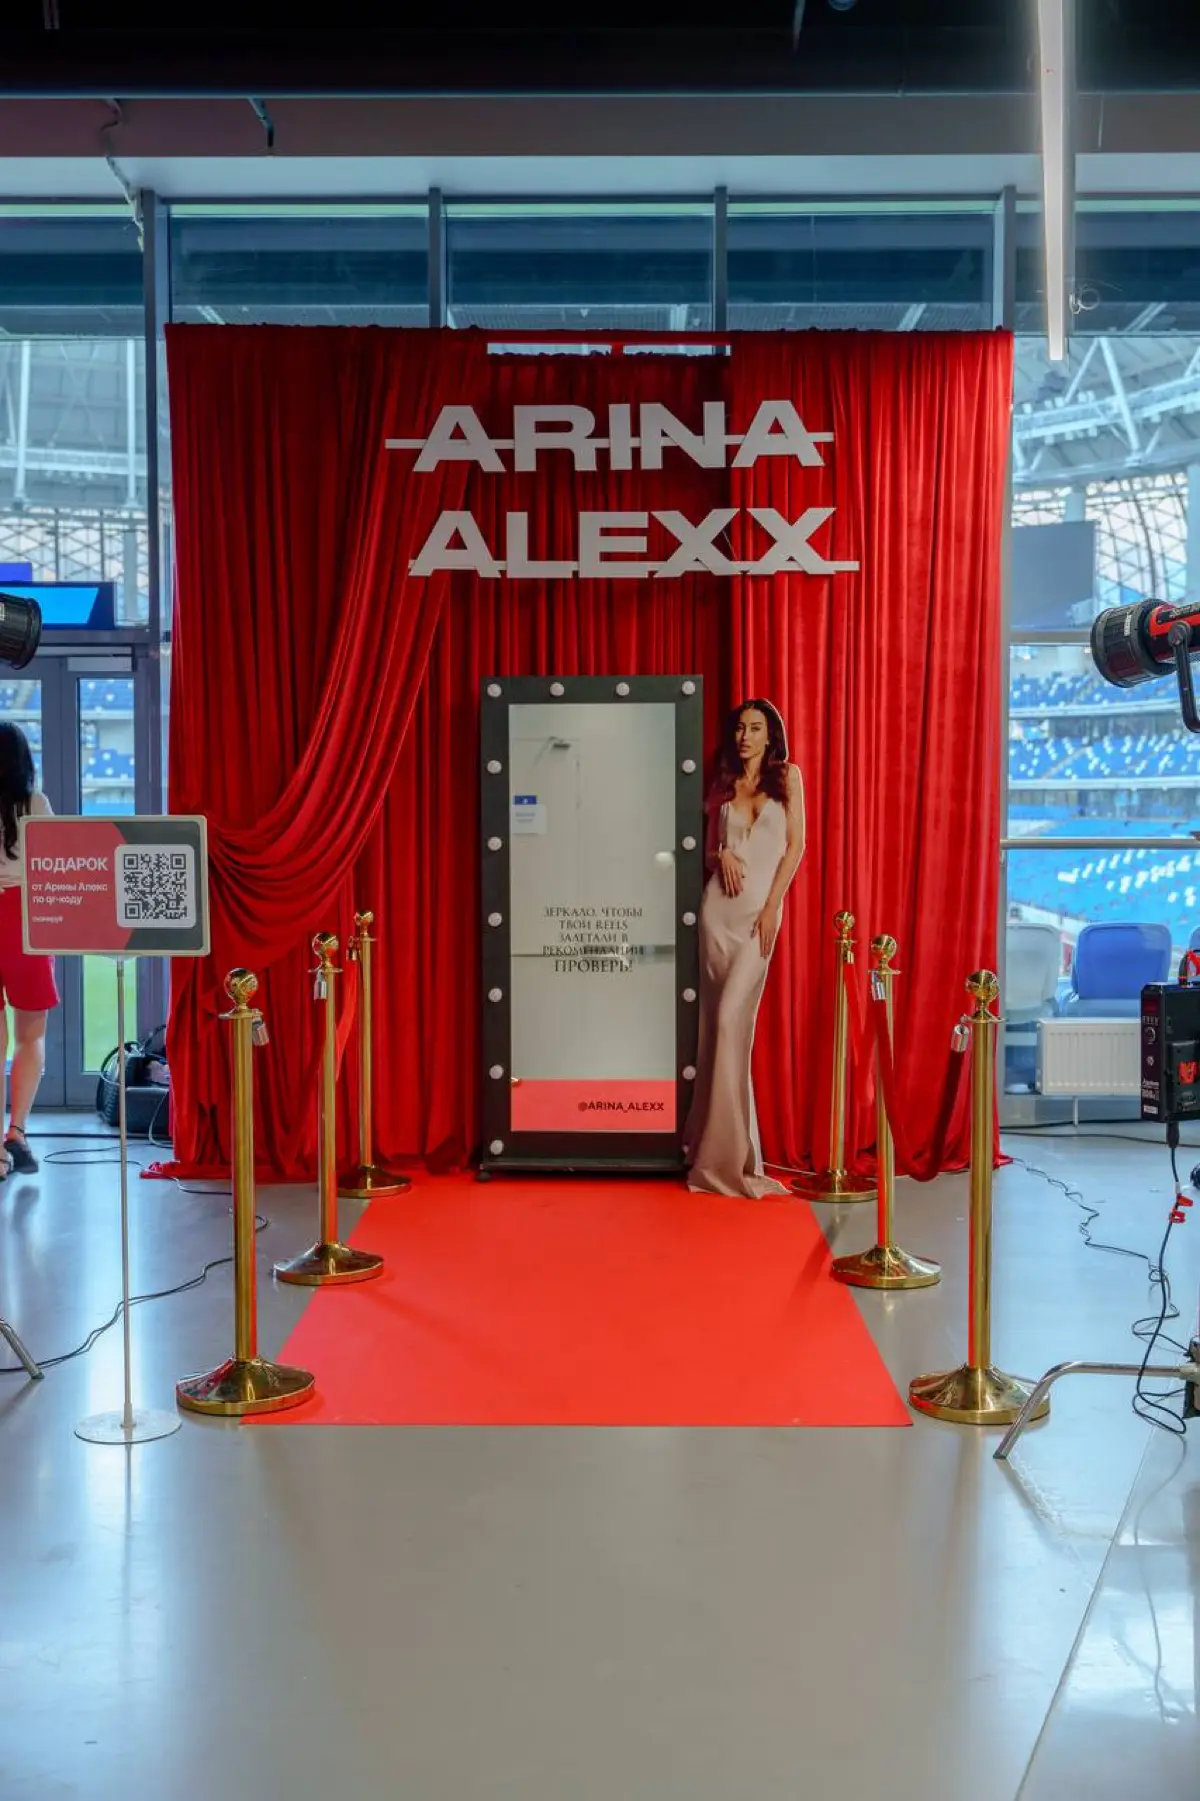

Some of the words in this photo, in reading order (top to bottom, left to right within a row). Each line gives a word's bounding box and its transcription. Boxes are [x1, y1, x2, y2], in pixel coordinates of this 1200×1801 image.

[408, 399, 829, 472] ARINA
[408, 507, 845, 579] ALEXX
[31, 857, 108, 873] ПОДАРОК
[44, 882, 77, 892] Арины
[78, 882, 108, 891] Алекс
[33, 895, 45, 903] по
[46, 895, 83, 905] qr-коду
[601, 906, 643, 916] ЧТОБЫ
[595, 919, 629, 929] REELS
[559, 932, 617, 942] ЗАЛЕТАЛИ
[555, 959, 634, 973] ПРОВЕРЬ!
[578, 1101, 665, 1113] @ARINA_ALEXX
